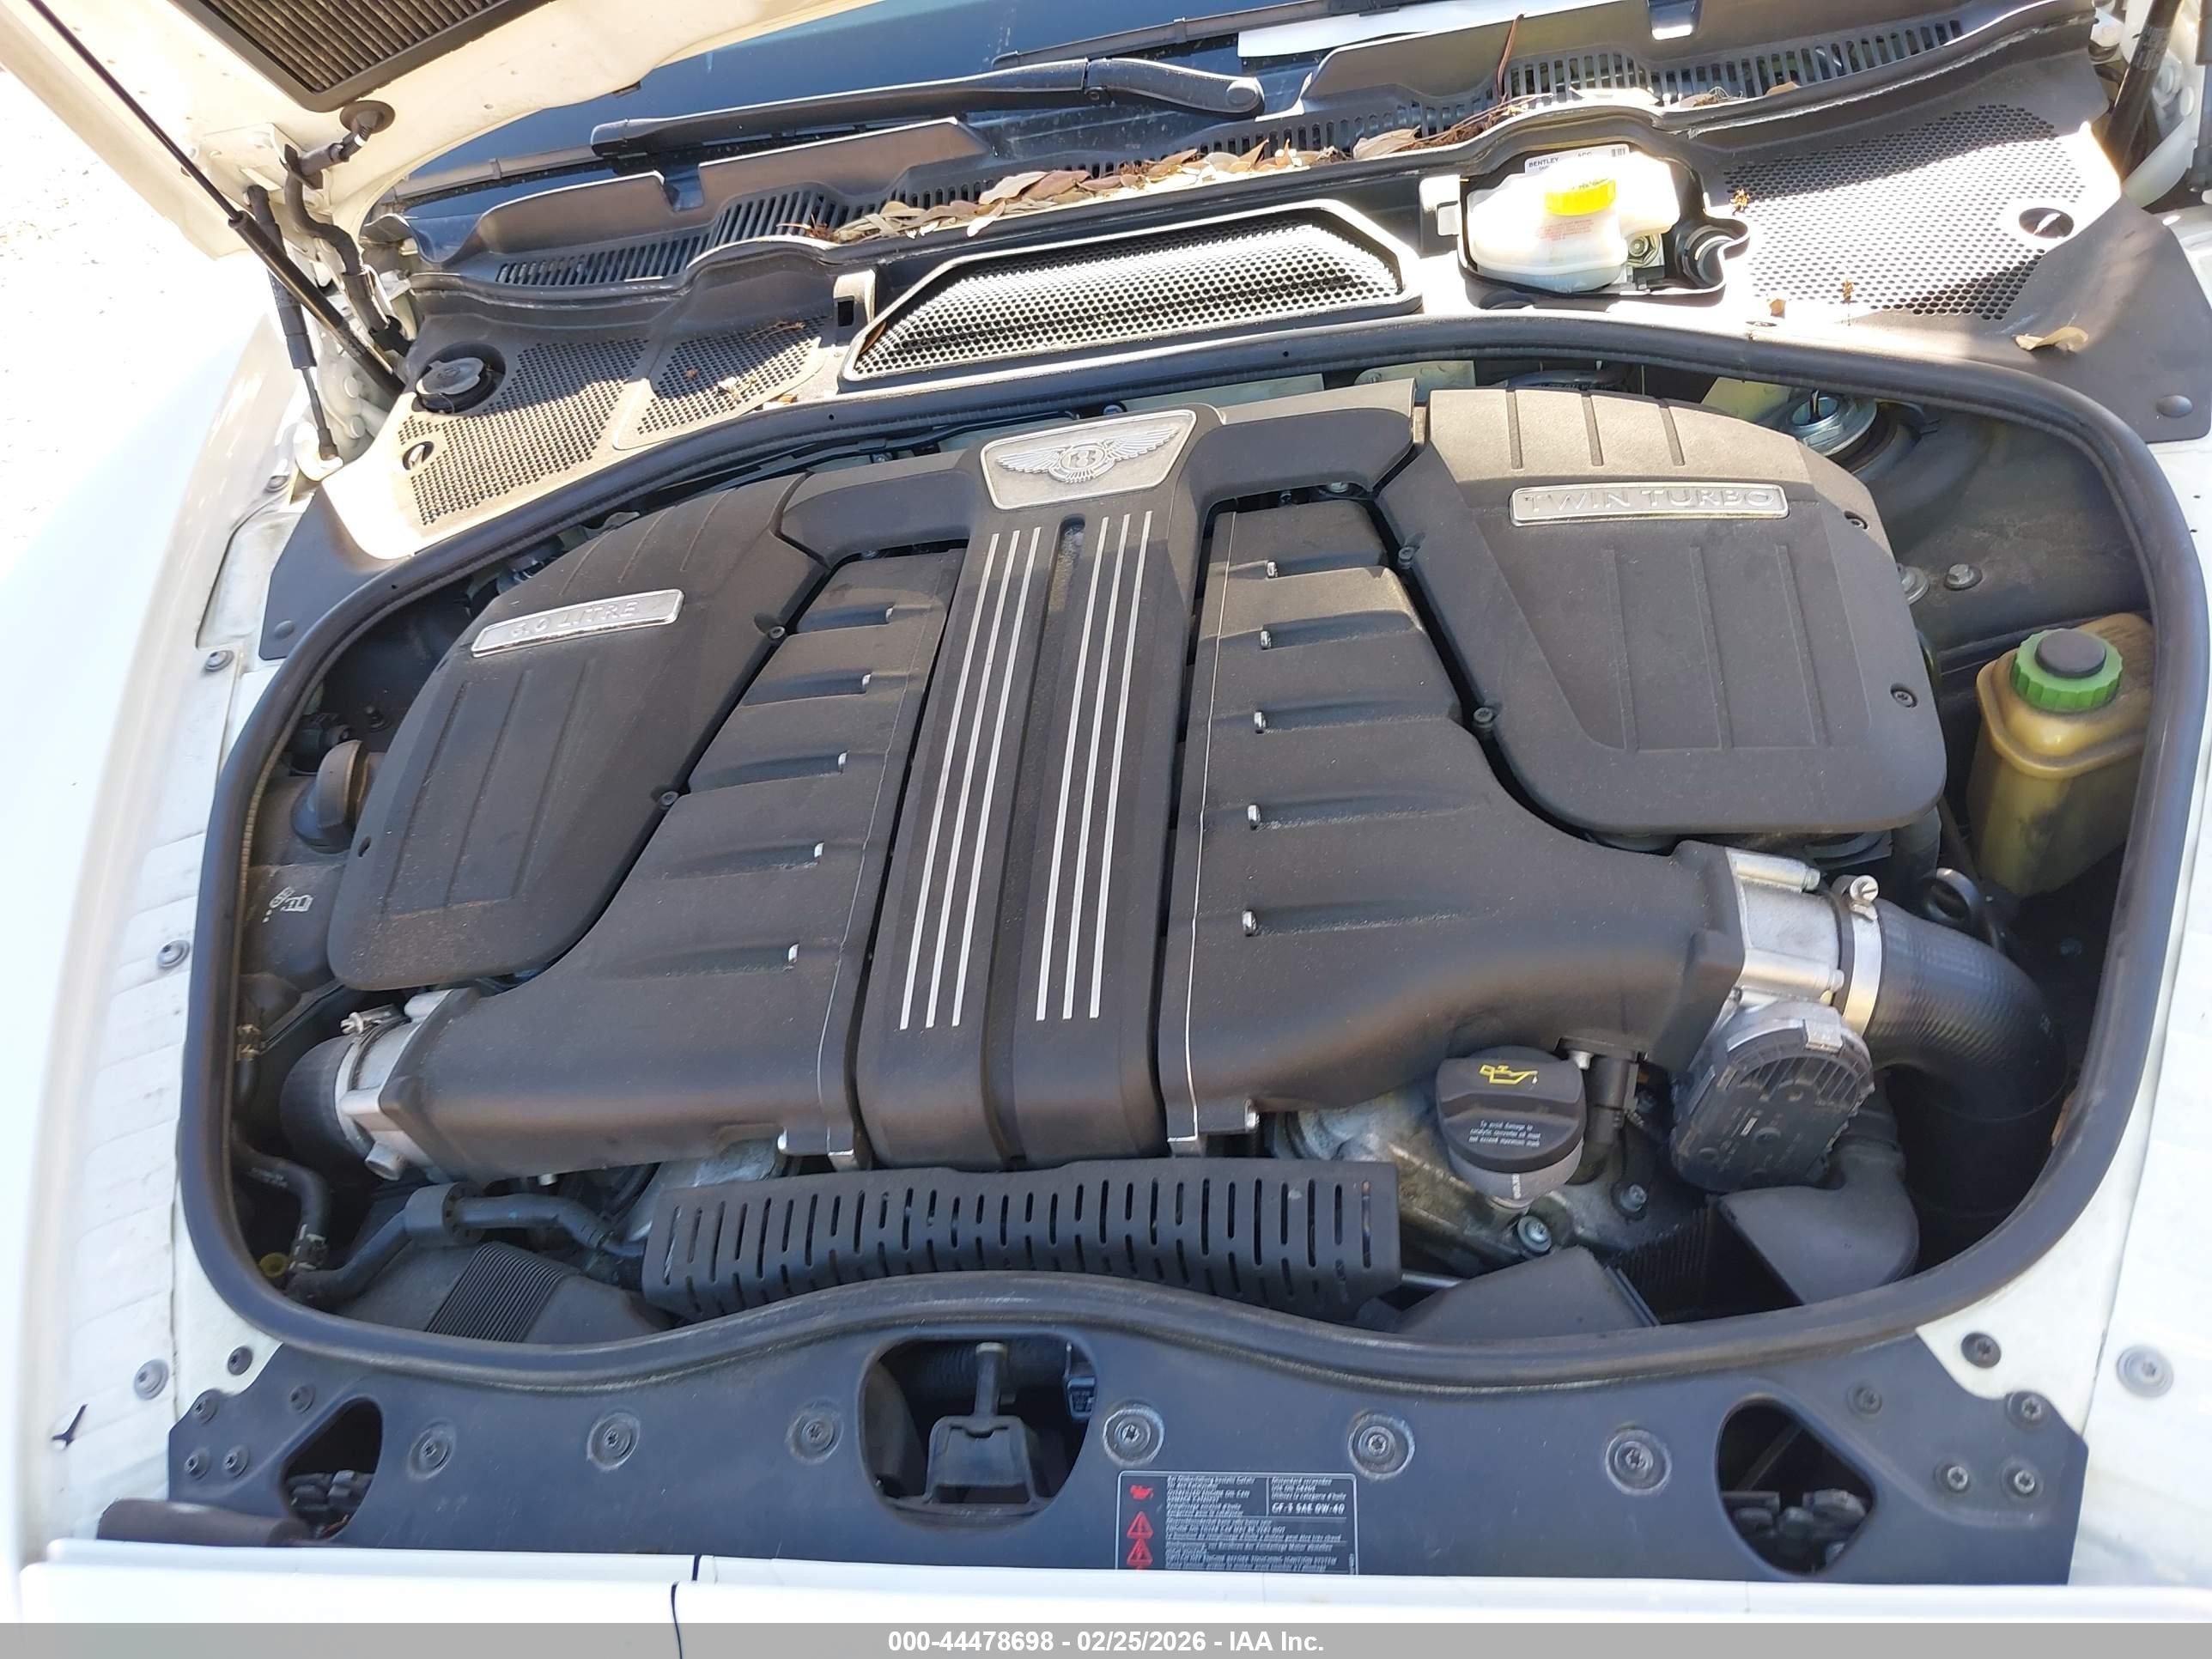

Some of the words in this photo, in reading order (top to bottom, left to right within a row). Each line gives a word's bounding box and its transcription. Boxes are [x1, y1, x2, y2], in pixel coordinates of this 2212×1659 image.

[1528, 156, 1559, 168] BENTLEY
[1524, 489, 1632, 514] TWIN
[1640, 488, 1776, 508] TURBO
[510, 616, 550, 638] 6.0
[558, 600, 640, 629] LITRE
[1296, 1502, 1314, 1514] SAE
[1315, 1503, 1346, 1515] 0W-40
